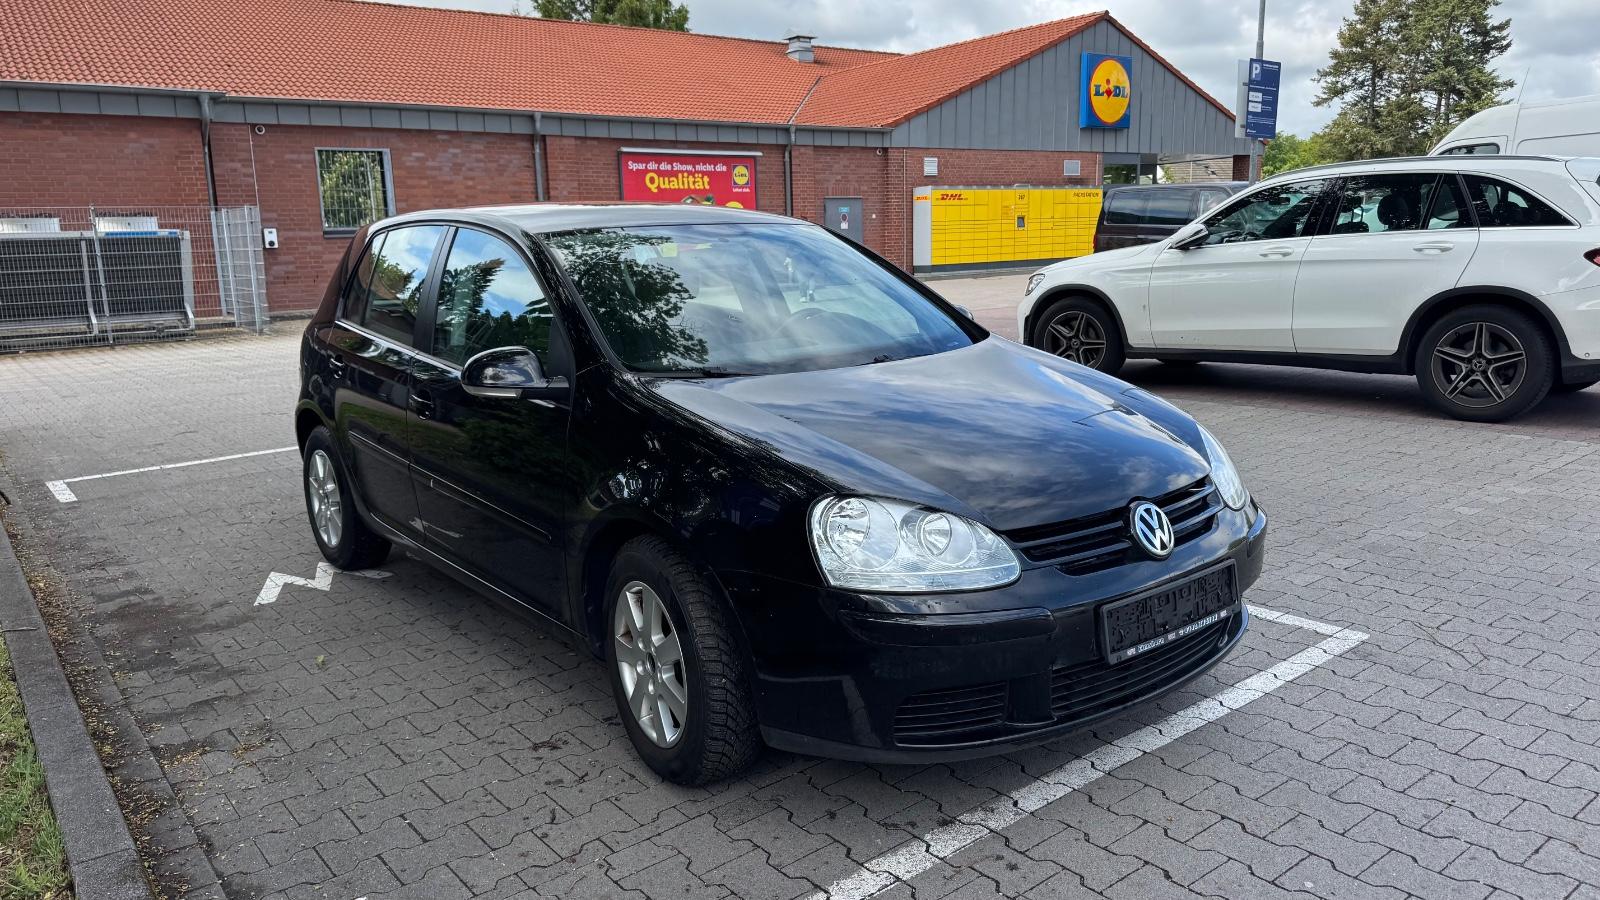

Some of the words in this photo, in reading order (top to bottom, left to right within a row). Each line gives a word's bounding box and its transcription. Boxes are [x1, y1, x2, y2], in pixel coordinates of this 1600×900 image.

[1252, 63, 1260, 79] P
[628, 161, 646, 171] Spar
[647, 161, 658, 171] dir
[660, 162, 671, 171] die
[673, 162, 695, 172] Show,
[696, 163, 714, 171] nicht
[716, 164, 727, 172] die
[645, 172, 710, 193] Qualität
